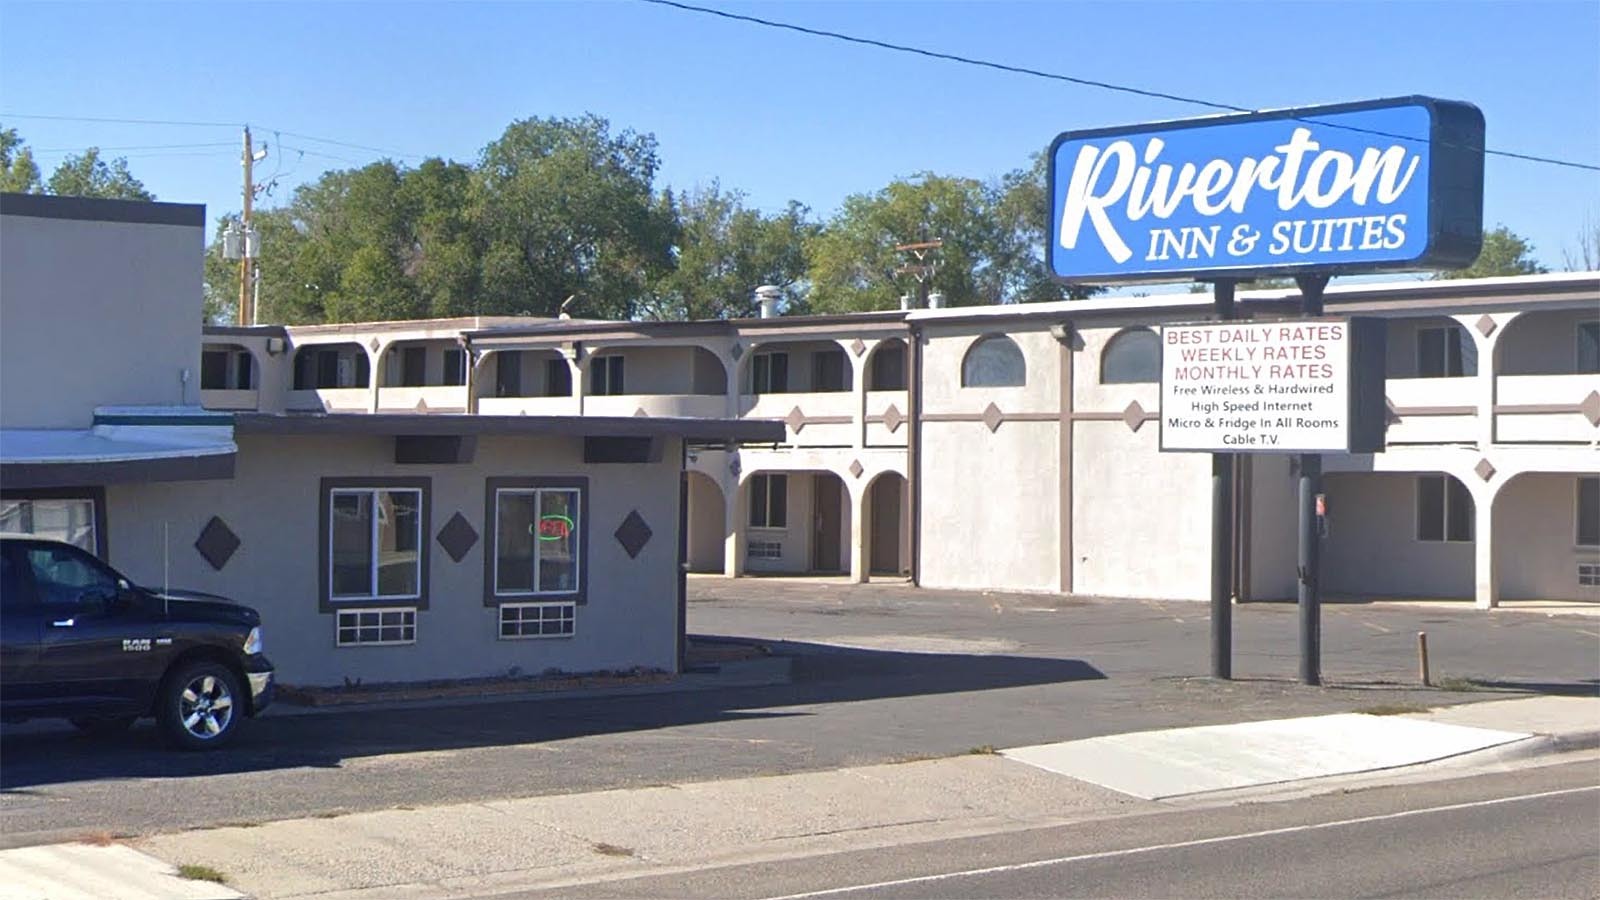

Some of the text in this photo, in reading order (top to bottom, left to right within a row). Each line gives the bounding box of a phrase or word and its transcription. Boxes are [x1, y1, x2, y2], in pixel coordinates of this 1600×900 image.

[1059, 127, 1420, 264] Riverton
[1146, 214, 1406, 260] INN & SUITES
[1168, 326, 1342, 344] BEST DAILY RATES
[1182, 345, 1325, 361] WEEKLY RATES
[1176, 364, 1332, 380] MONTHLY RATES
[1174, 384, 1333, 395] Free Wireless & Hardwired
[1192, 401, 1312, 414] High Speed Internet
[1169, 418, 1338, 430] Micro & Fridge In All Rooms
[1223, 435, 1280, 445] Cable T.V.
